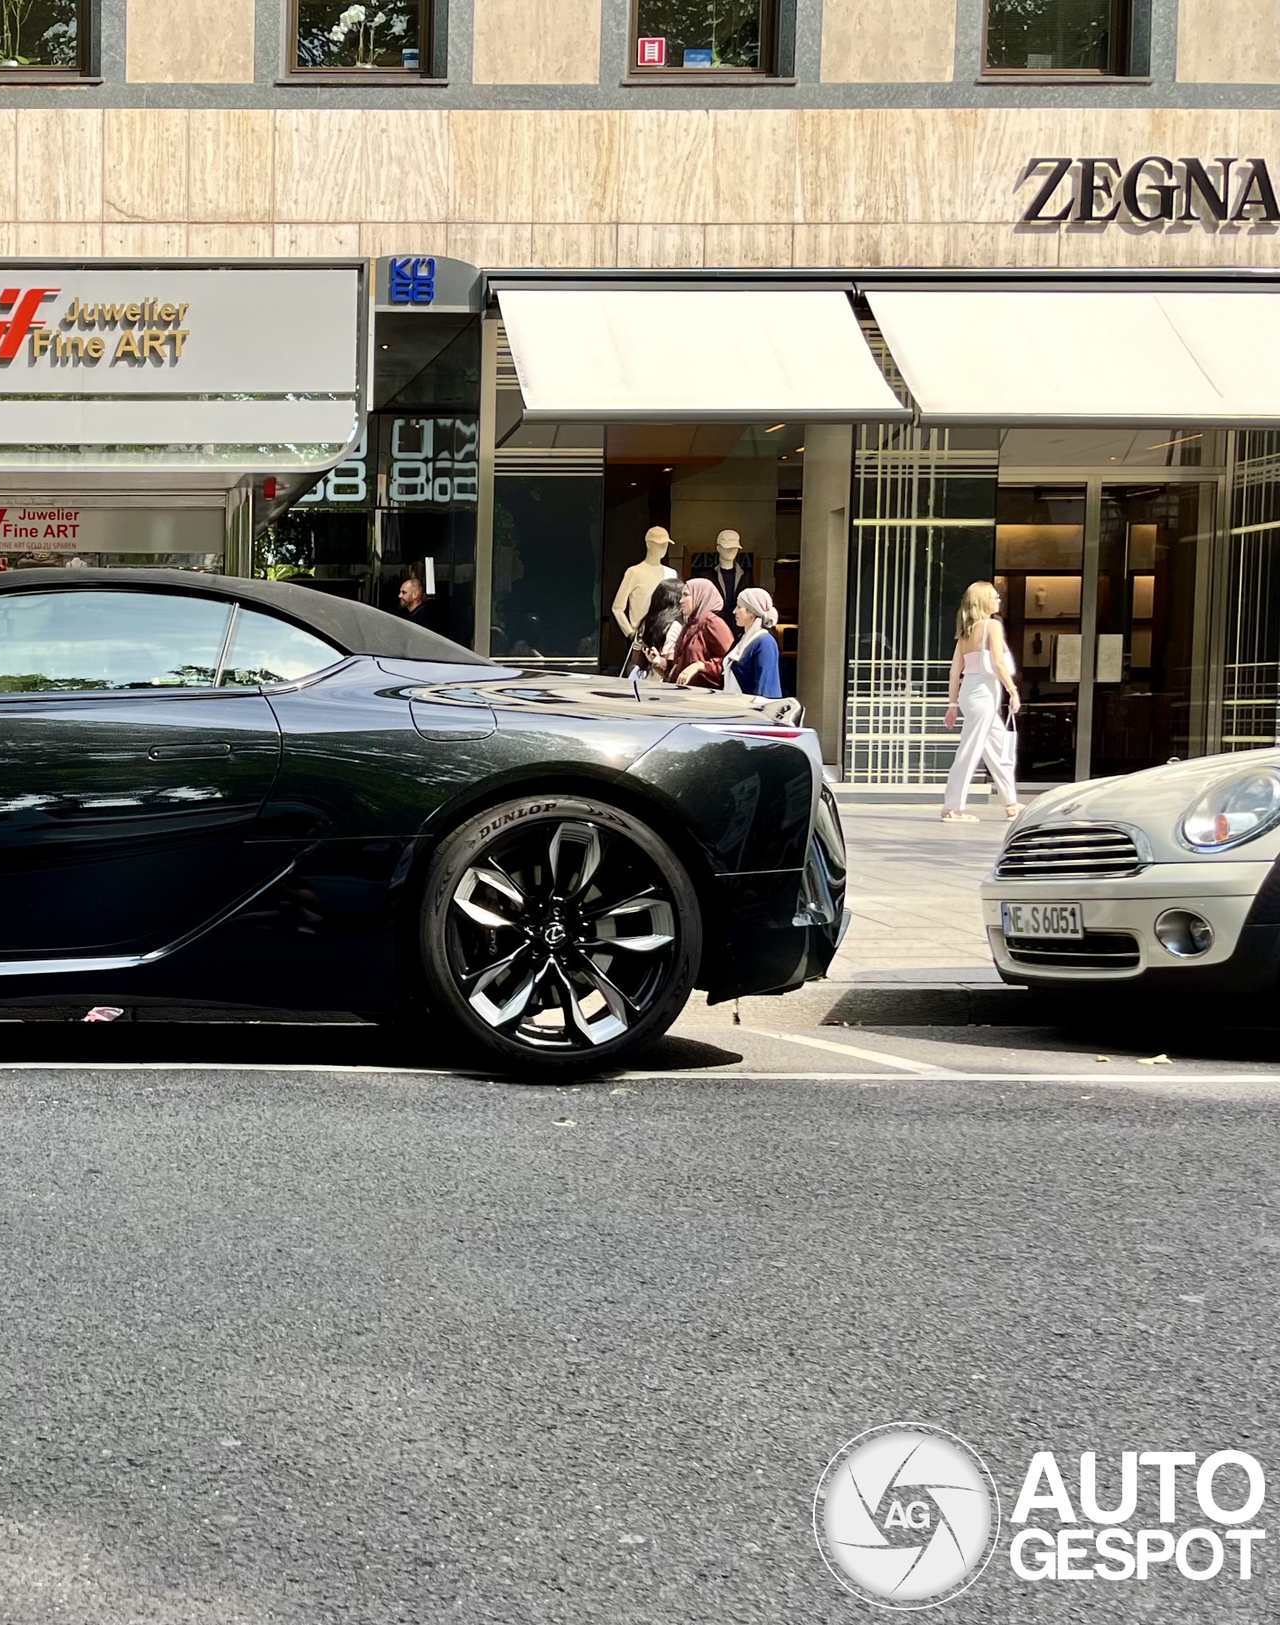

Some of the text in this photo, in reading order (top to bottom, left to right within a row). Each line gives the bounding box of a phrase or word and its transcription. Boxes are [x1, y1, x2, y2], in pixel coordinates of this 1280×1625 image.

[1023, 156, 1280, 222] ZEGNA
[392, 280, 434, 302] 68
[64, 297, 190, 323] Juwelier
[33, 329, 190, 358] Fine ART
[18, 508, 80, 521] Juwelier
[3, 524, 80, 538] Fine ART
[14, 541, 25, 549] ART
[26, 541, 42, 550] GELD
[43, 541, 51, 550] ZU
[52, 542, 77, 550] SPAREN
[479, 802, 557, 841] DUNLOP
